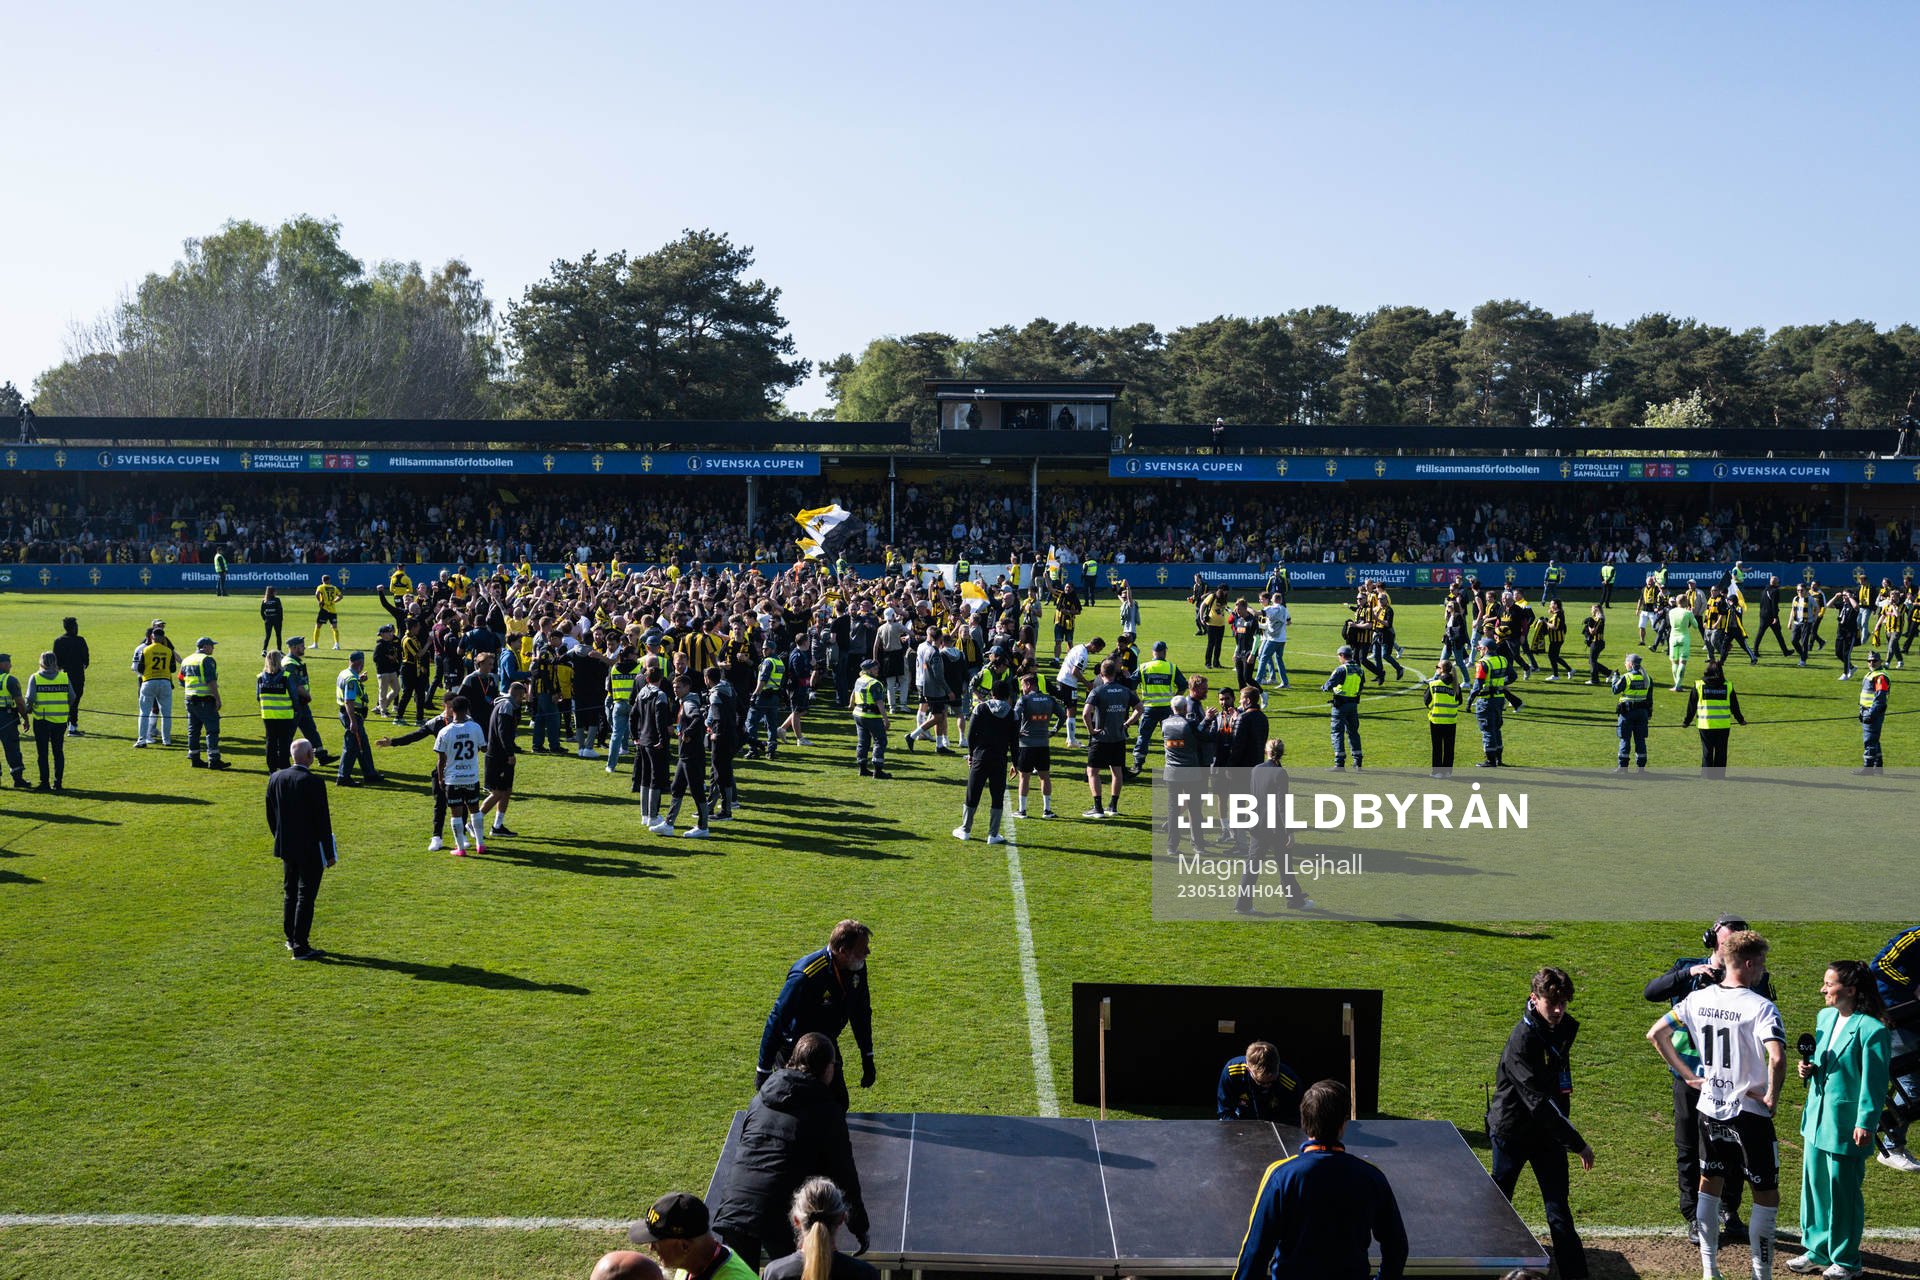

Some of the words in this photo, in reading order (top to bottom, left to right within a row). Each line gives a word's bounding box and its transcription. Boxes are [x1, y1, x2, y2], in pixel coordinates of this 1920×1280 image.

[117, 455, 175, 465] SVENSKA
[177, 455, 220, 465] CUPEN
[389, 457, 514, 467] #tillsammansförfotbollen
[705, 459, 761, 468] SVENSKA
[763, 459, 804, 469] CUPEN
[1144, 462, 1200, 471] SVENSKA
[1202, 462, 1243, 472] CUPEN
[1415, 464, 1540, 474] #tillsammansförfotbollen
[1731, 466, 1787, 476] SVENSKA
[1790, 467, 1830, 476] CUPEN
[1199, 571, 1326, 581] #tillsammansftbollen
[152, 656, 167, 670] 21
[453, 740, 475, 761] 23
[1698, 1006, 1742, 1021] GUSTAFSON
[1702, 1024, 1731, 1069] 11
[1799, 1044, 1814, 1052] svt
